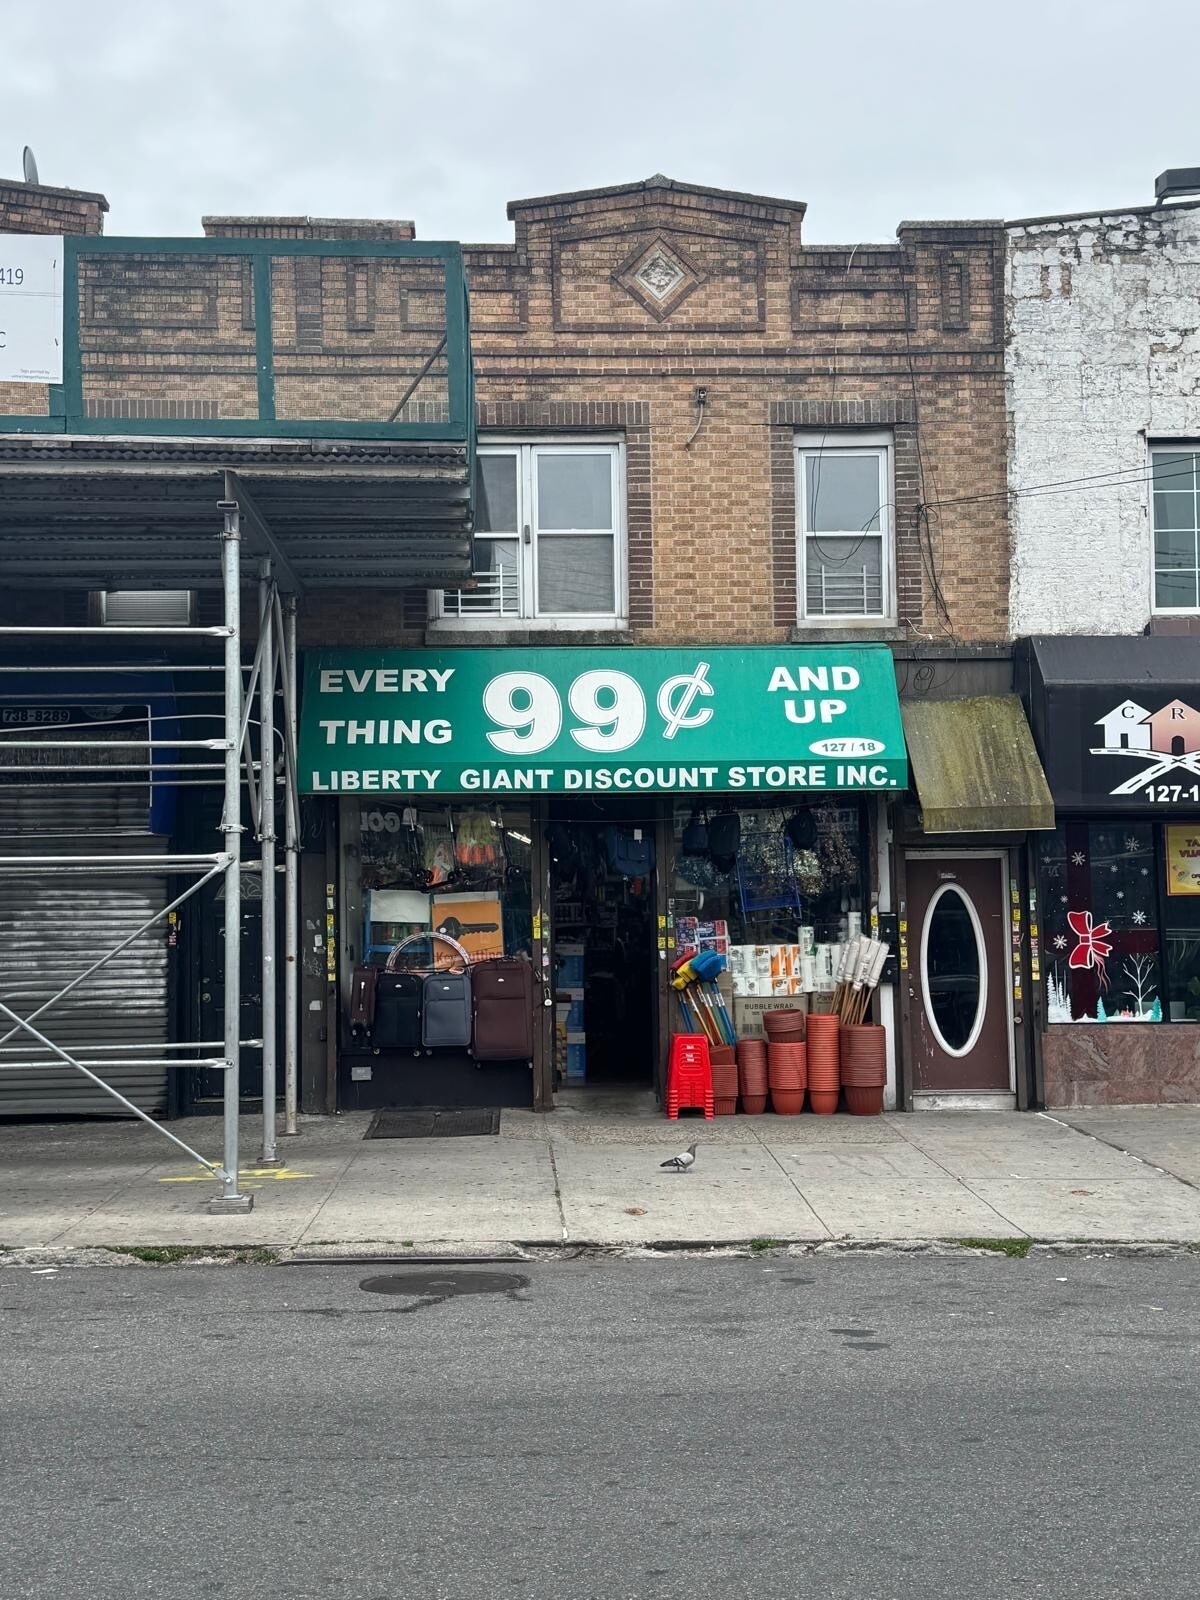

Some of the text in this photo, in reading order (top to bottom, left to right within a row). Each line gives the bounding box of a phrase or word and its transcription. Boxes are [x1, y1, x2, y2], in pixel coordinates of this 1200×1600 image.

[319, 669, 456, 693] EVERY
[767, 666, 860, 691] AND
[4, 710, 69, 722] 738-8289
[784, 699, 847, 724] UP
[1121, 706, 1186, 720] C R
[319, 719, 453, 745] THING
[312, 765, 897, 791] LIBERTY GIANT DISCOUNT STORE INC.
[1145, 784, 1200, 803] 127-1
[744, 1002, 794, 1010] BUBBLE WRAP
